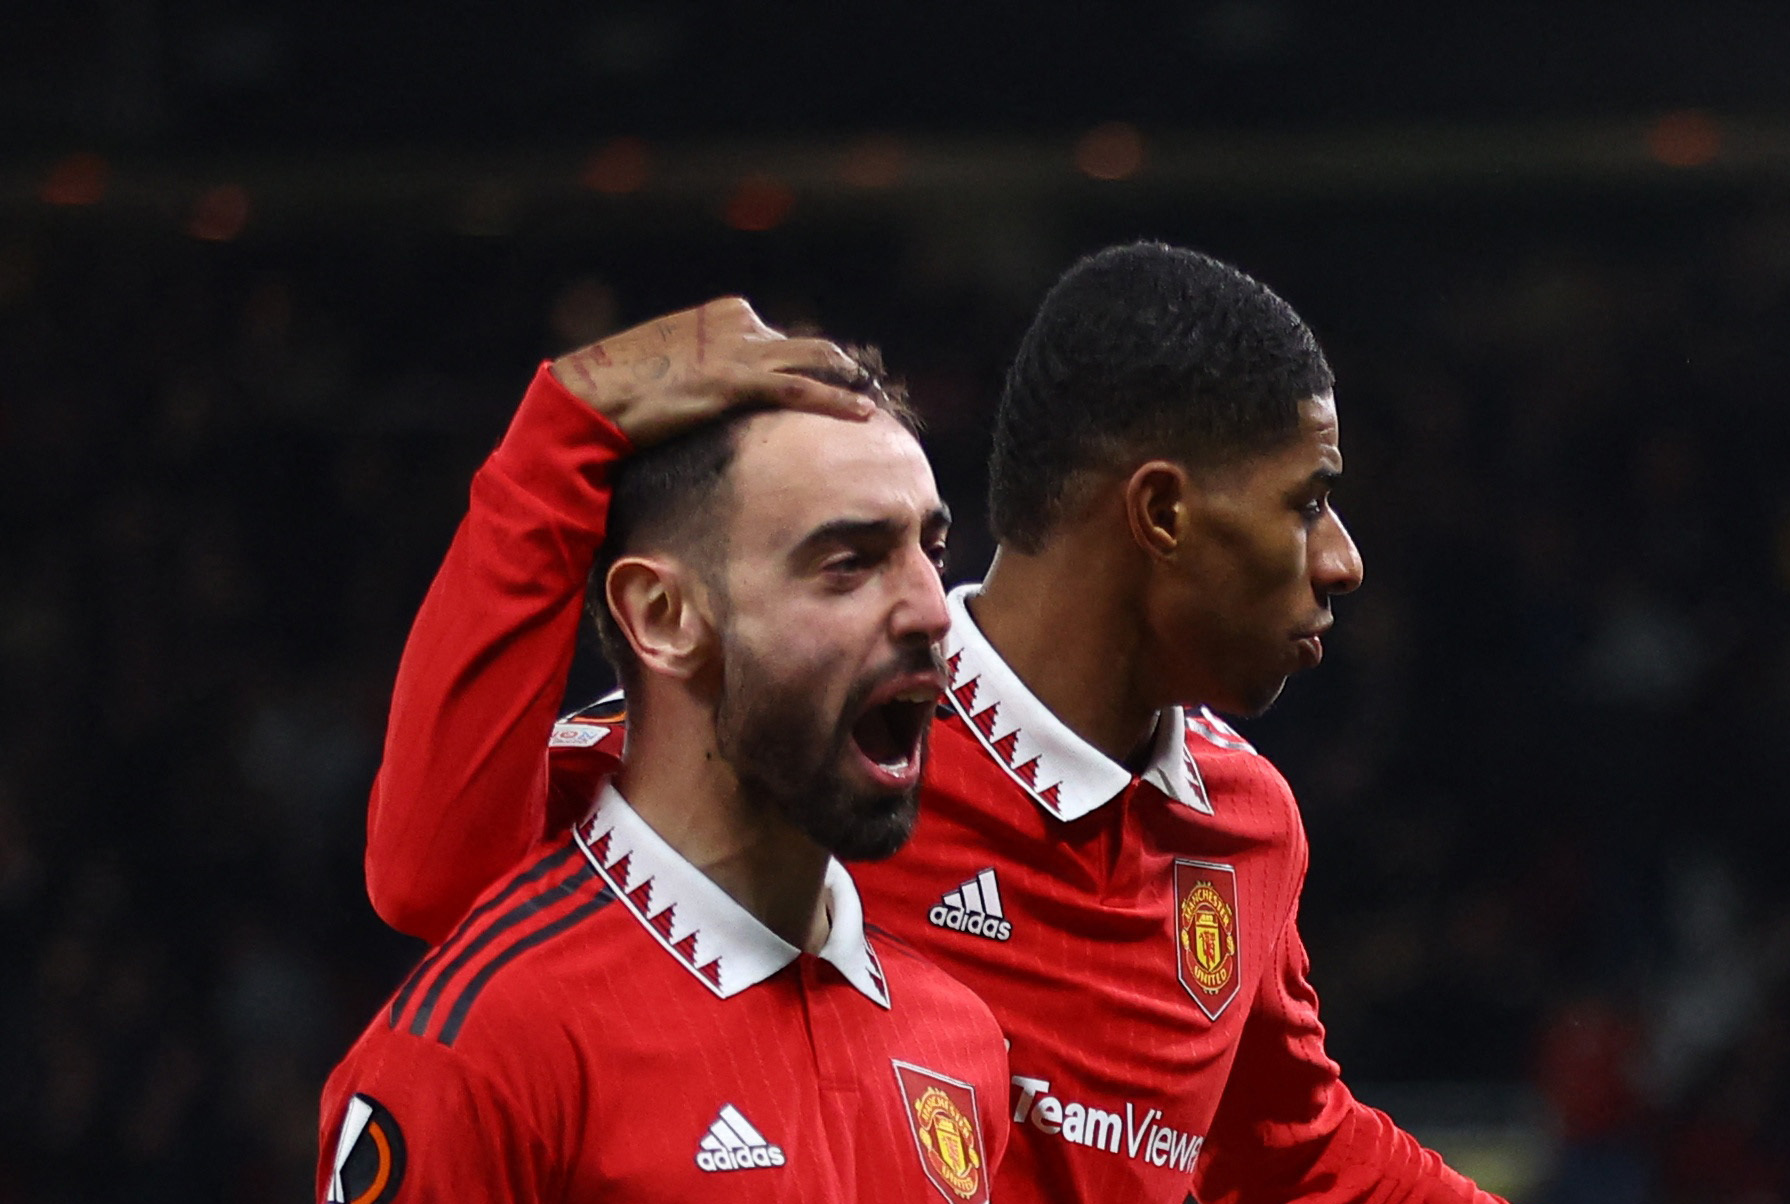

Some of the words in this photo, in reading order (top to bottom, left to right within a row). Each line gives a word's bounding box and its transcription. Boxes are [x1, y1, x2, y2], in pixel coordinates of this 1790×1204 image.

[929, 906, 1012, 941] adidas
[1184, 889, 1230, 927] MANCHESTER
[1193, 965, 1227, 986] UNITED
[696, 1145, 786, 1172] adidas
